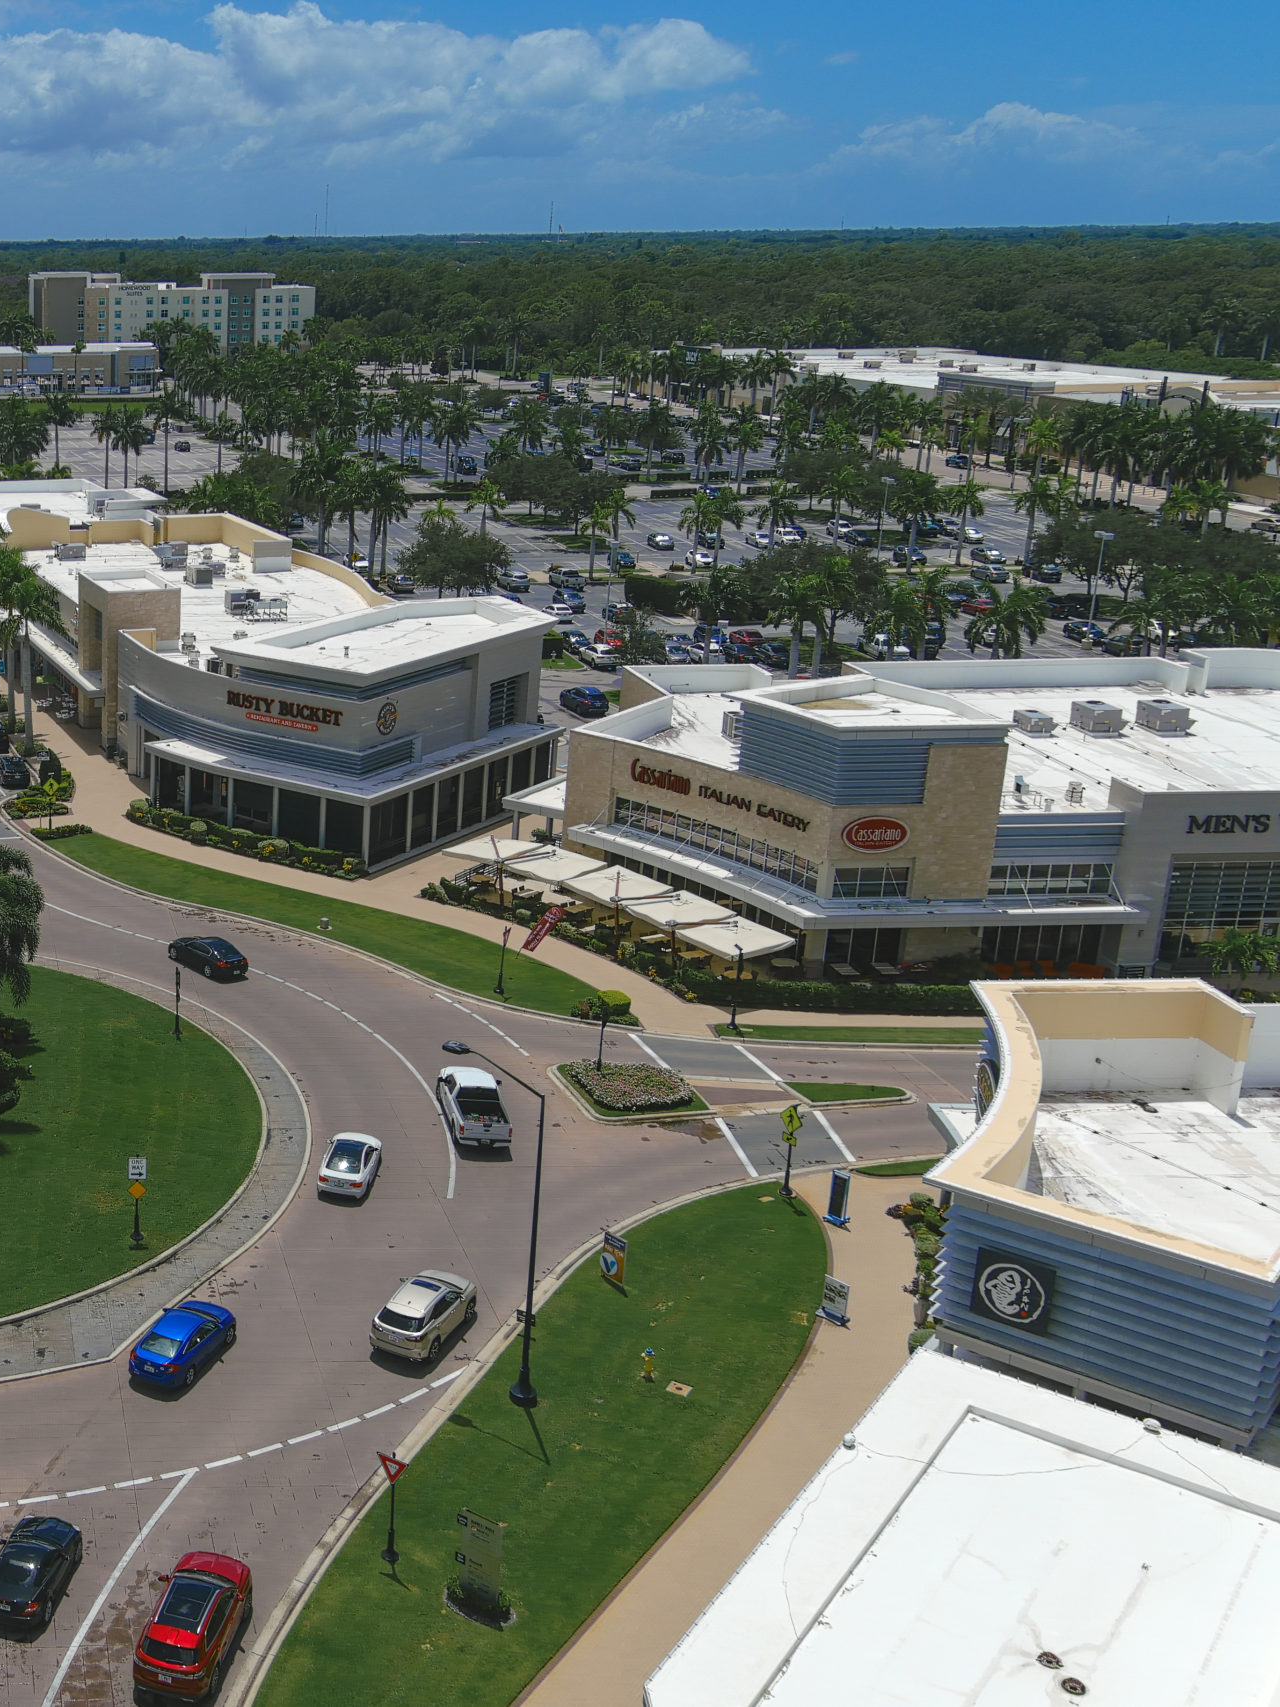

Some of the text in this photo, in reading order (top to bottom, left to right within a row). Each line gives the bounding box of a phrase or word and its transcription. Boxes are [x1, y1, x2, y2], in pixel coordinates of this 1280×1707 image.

[227, 690, 343, 727] RUSTY BUCKET
[250, 713, 281, 726] RESTAURANT
[293, 721, 313, 731] TAVERN
[631, 758, 810, 833] Cassariano ITALIAN EATERY
[852, 825, 902, 842] Cassariano
[1186, 814, 1271, 834] MEN'S
